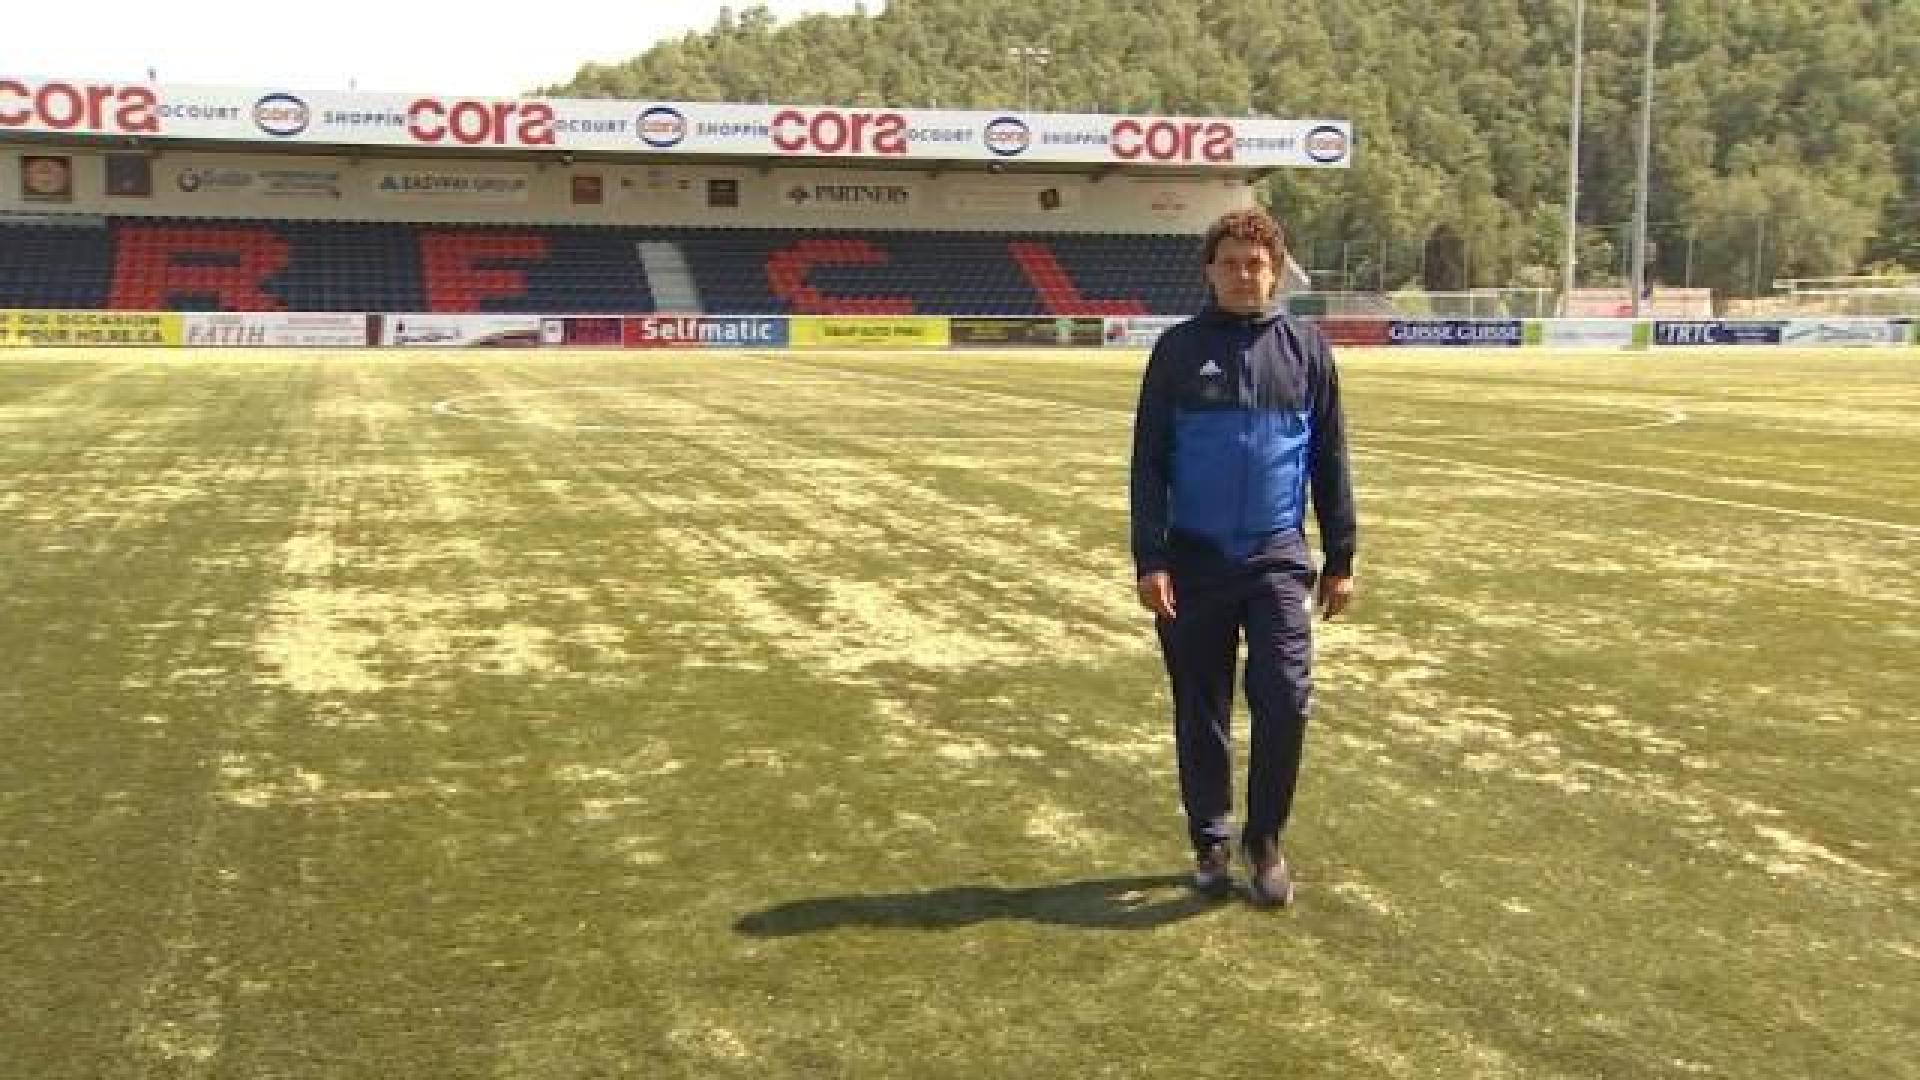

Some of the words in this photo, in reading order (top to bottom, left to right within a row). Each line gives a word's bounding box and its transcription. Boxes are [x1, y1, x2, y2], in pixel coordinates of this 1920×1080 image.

[0, 81, 159, 132] cora
[407, 98, 555, 144] cora
[772, 110, 907, 154] cora
[1111, 120, 1233, 161] cora
[816, 184, 910, 204] PARTNERS
[187, 324, 265, 344] FATIH
[641, 318, 772, 341] Selfmatic
